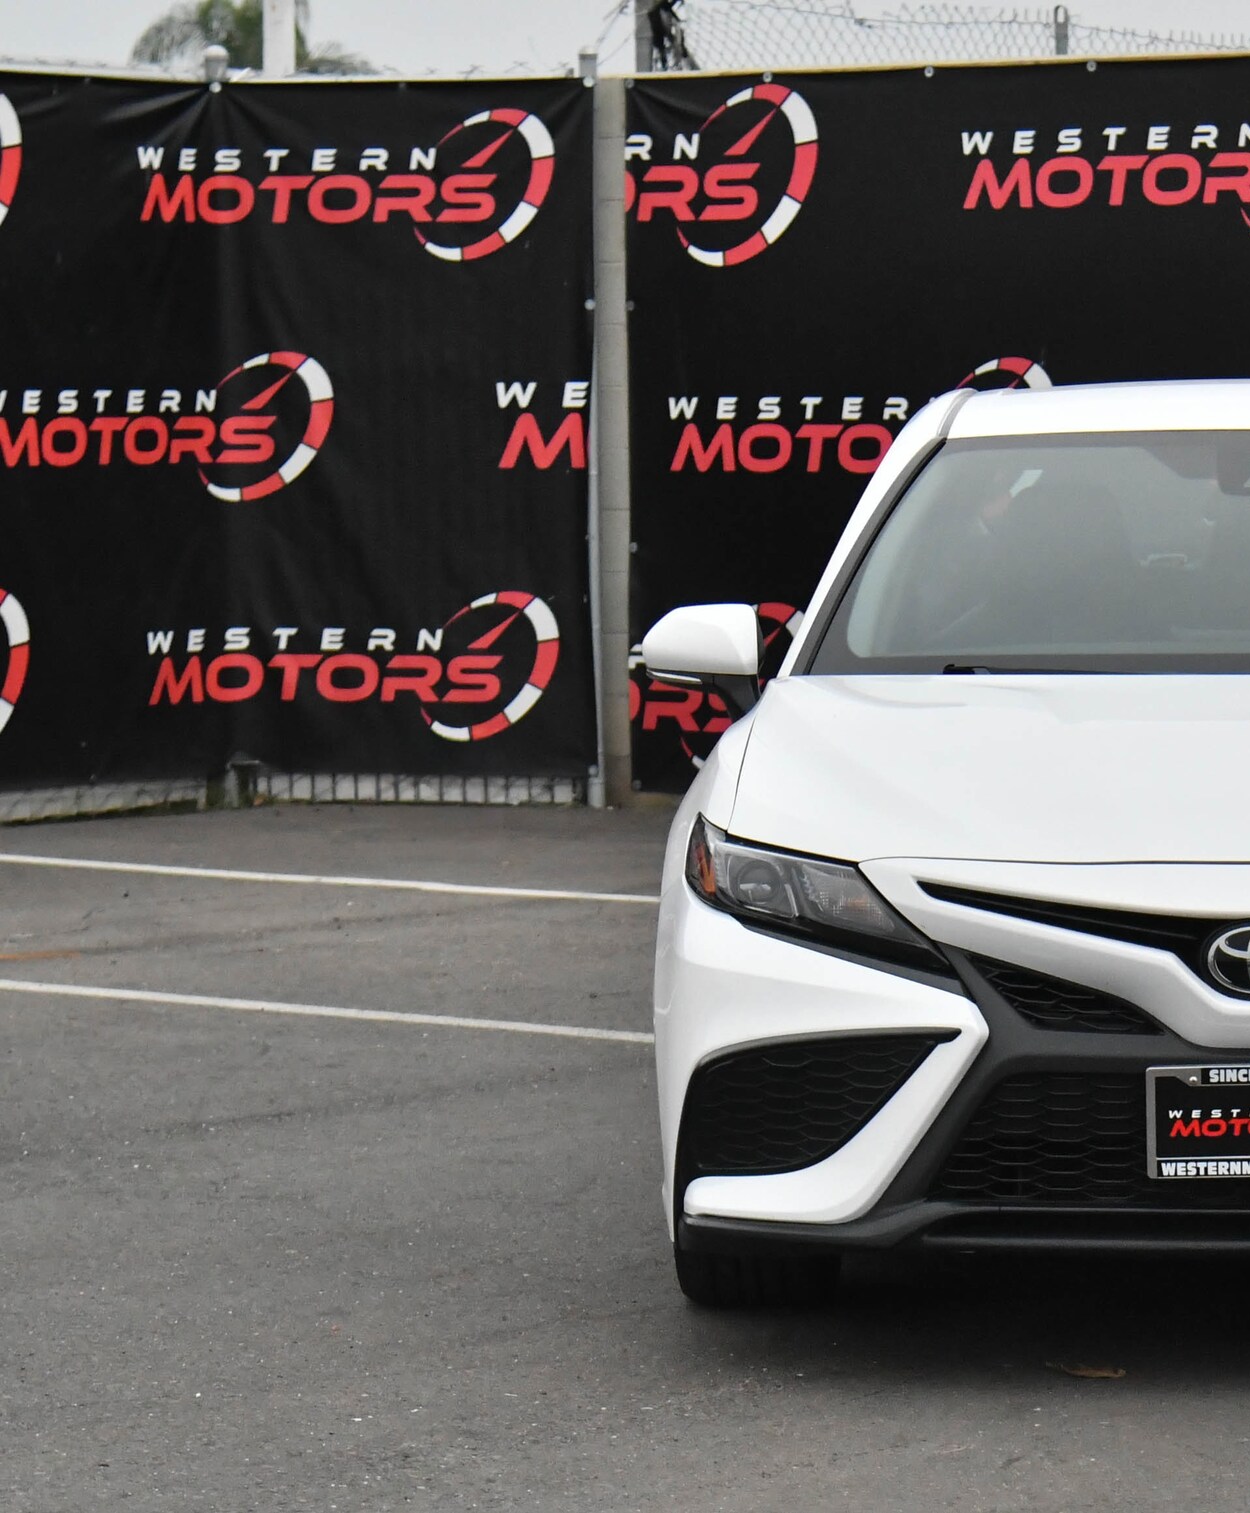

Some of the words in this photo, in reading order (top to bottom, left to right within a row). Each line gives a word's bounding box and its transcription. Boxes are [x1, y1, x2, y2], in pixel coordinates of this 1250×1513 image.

[137, 146, 437, 172] WESTERN
[140, 173, 497, 225] MOTORS
[625, 162, 761, 222] RS
[0, 389, 217, 414] ESTERN
[495, 381, 589, 408] WE
[668, 396, 936, 420] WESTER
[0, 415, 277, 467] MOTORS
[498, 412, 590, 469] M
[147, 627, 444, 655] WESTERN
[149, 654, 503, 705] MOTORS
